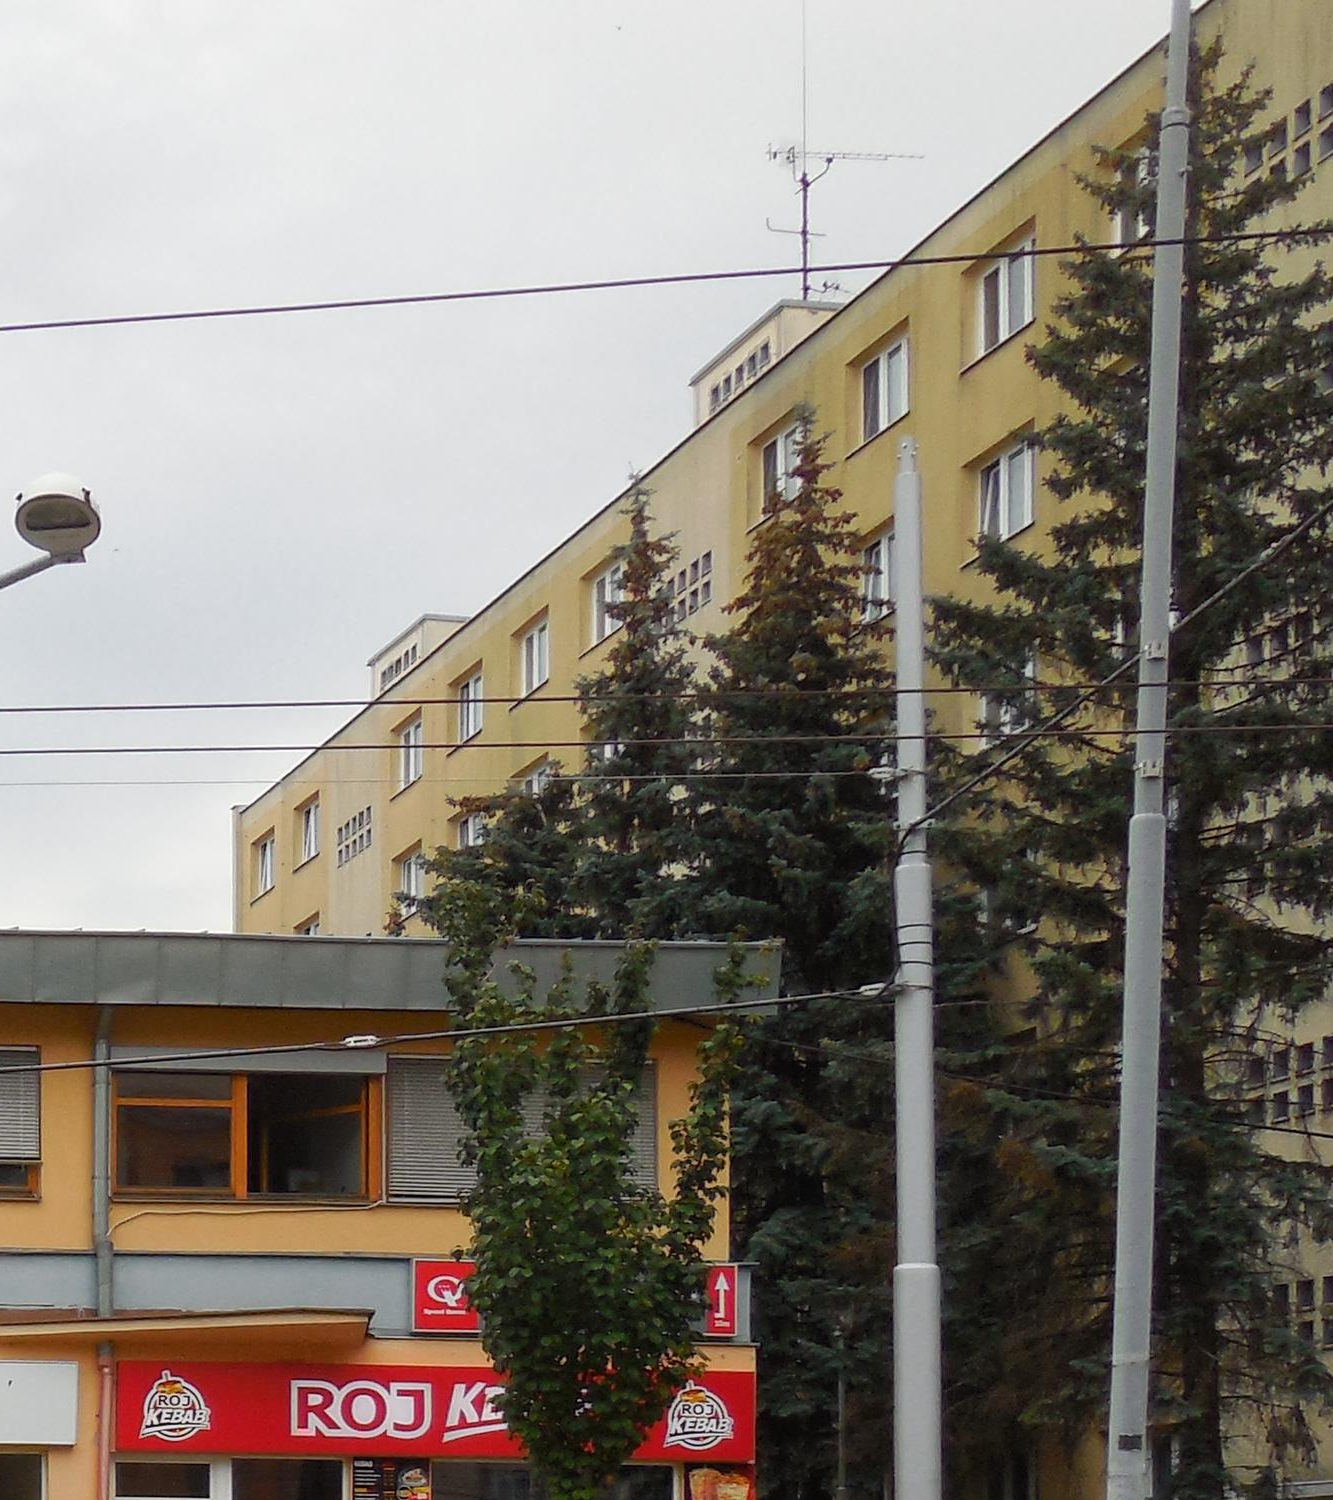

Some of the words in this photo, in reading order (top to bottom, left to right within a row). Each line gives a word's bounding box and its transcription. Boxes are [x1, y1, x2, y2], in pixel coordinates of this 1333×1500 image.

[158, 1395, 191, 1407] ROJ
[290, 1380, 432, 1439] ROJ
[682, 1404, 714, 1415] ROJ
[146, 1408, 207, 1427] KEBAB
[670, 1416, 731, 1434] KEBAB
